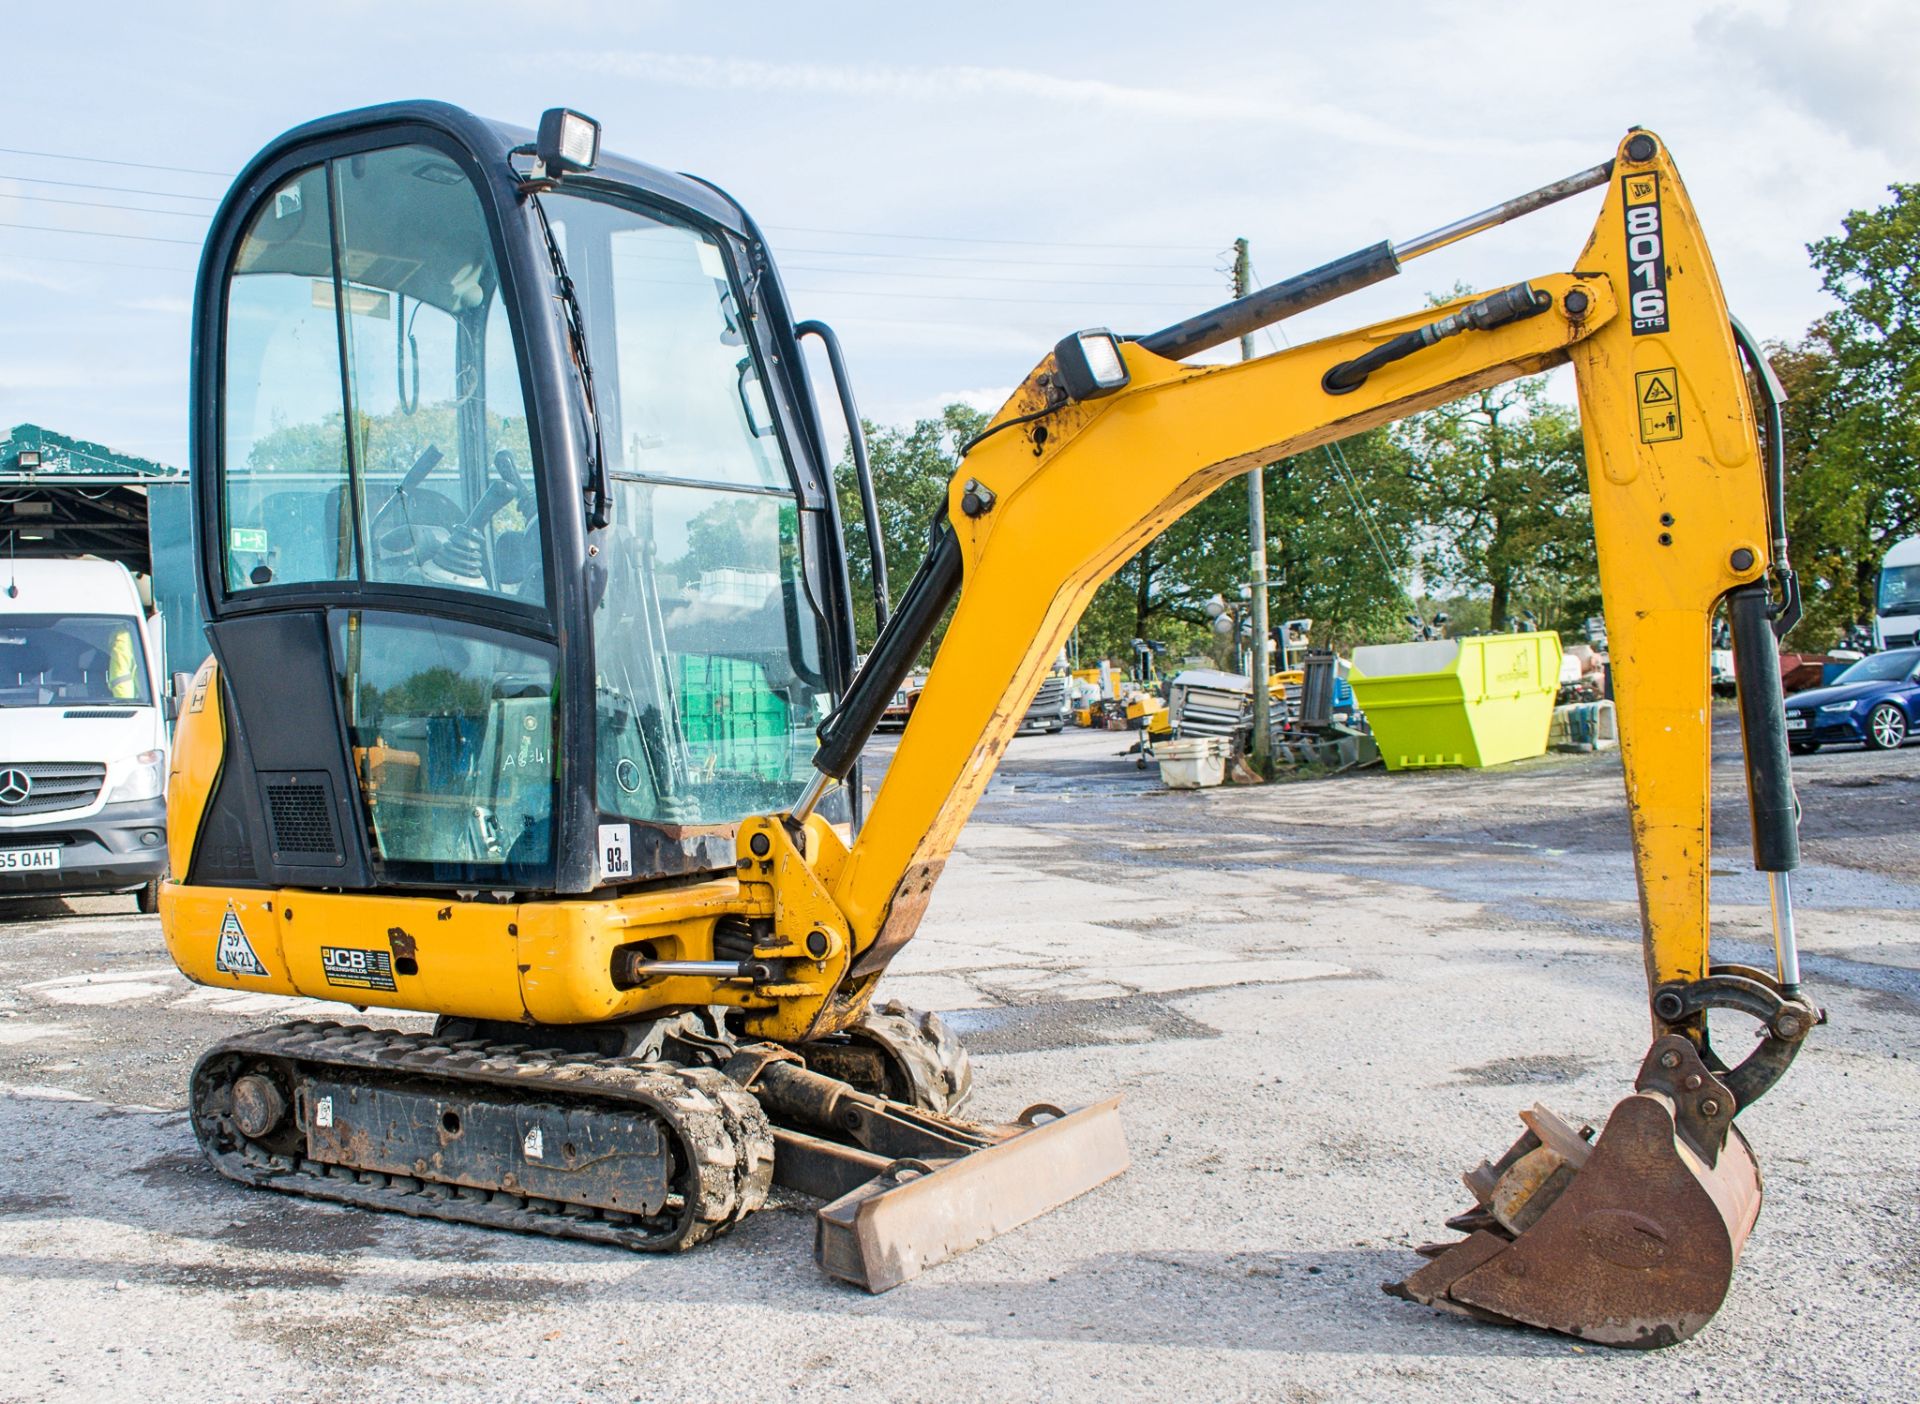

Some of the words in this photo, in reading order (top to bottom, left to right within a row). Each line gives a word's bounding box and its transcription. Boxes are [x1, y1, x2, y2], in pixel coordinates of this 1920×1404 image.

[1627, 206, 1665, 318] 8016
[1634, 317, 1665, 329] CTS
[22, 851, 53, 867] OAH
[226, 930, 240, 947] 59
[323, 948, 366, 969] JCB
